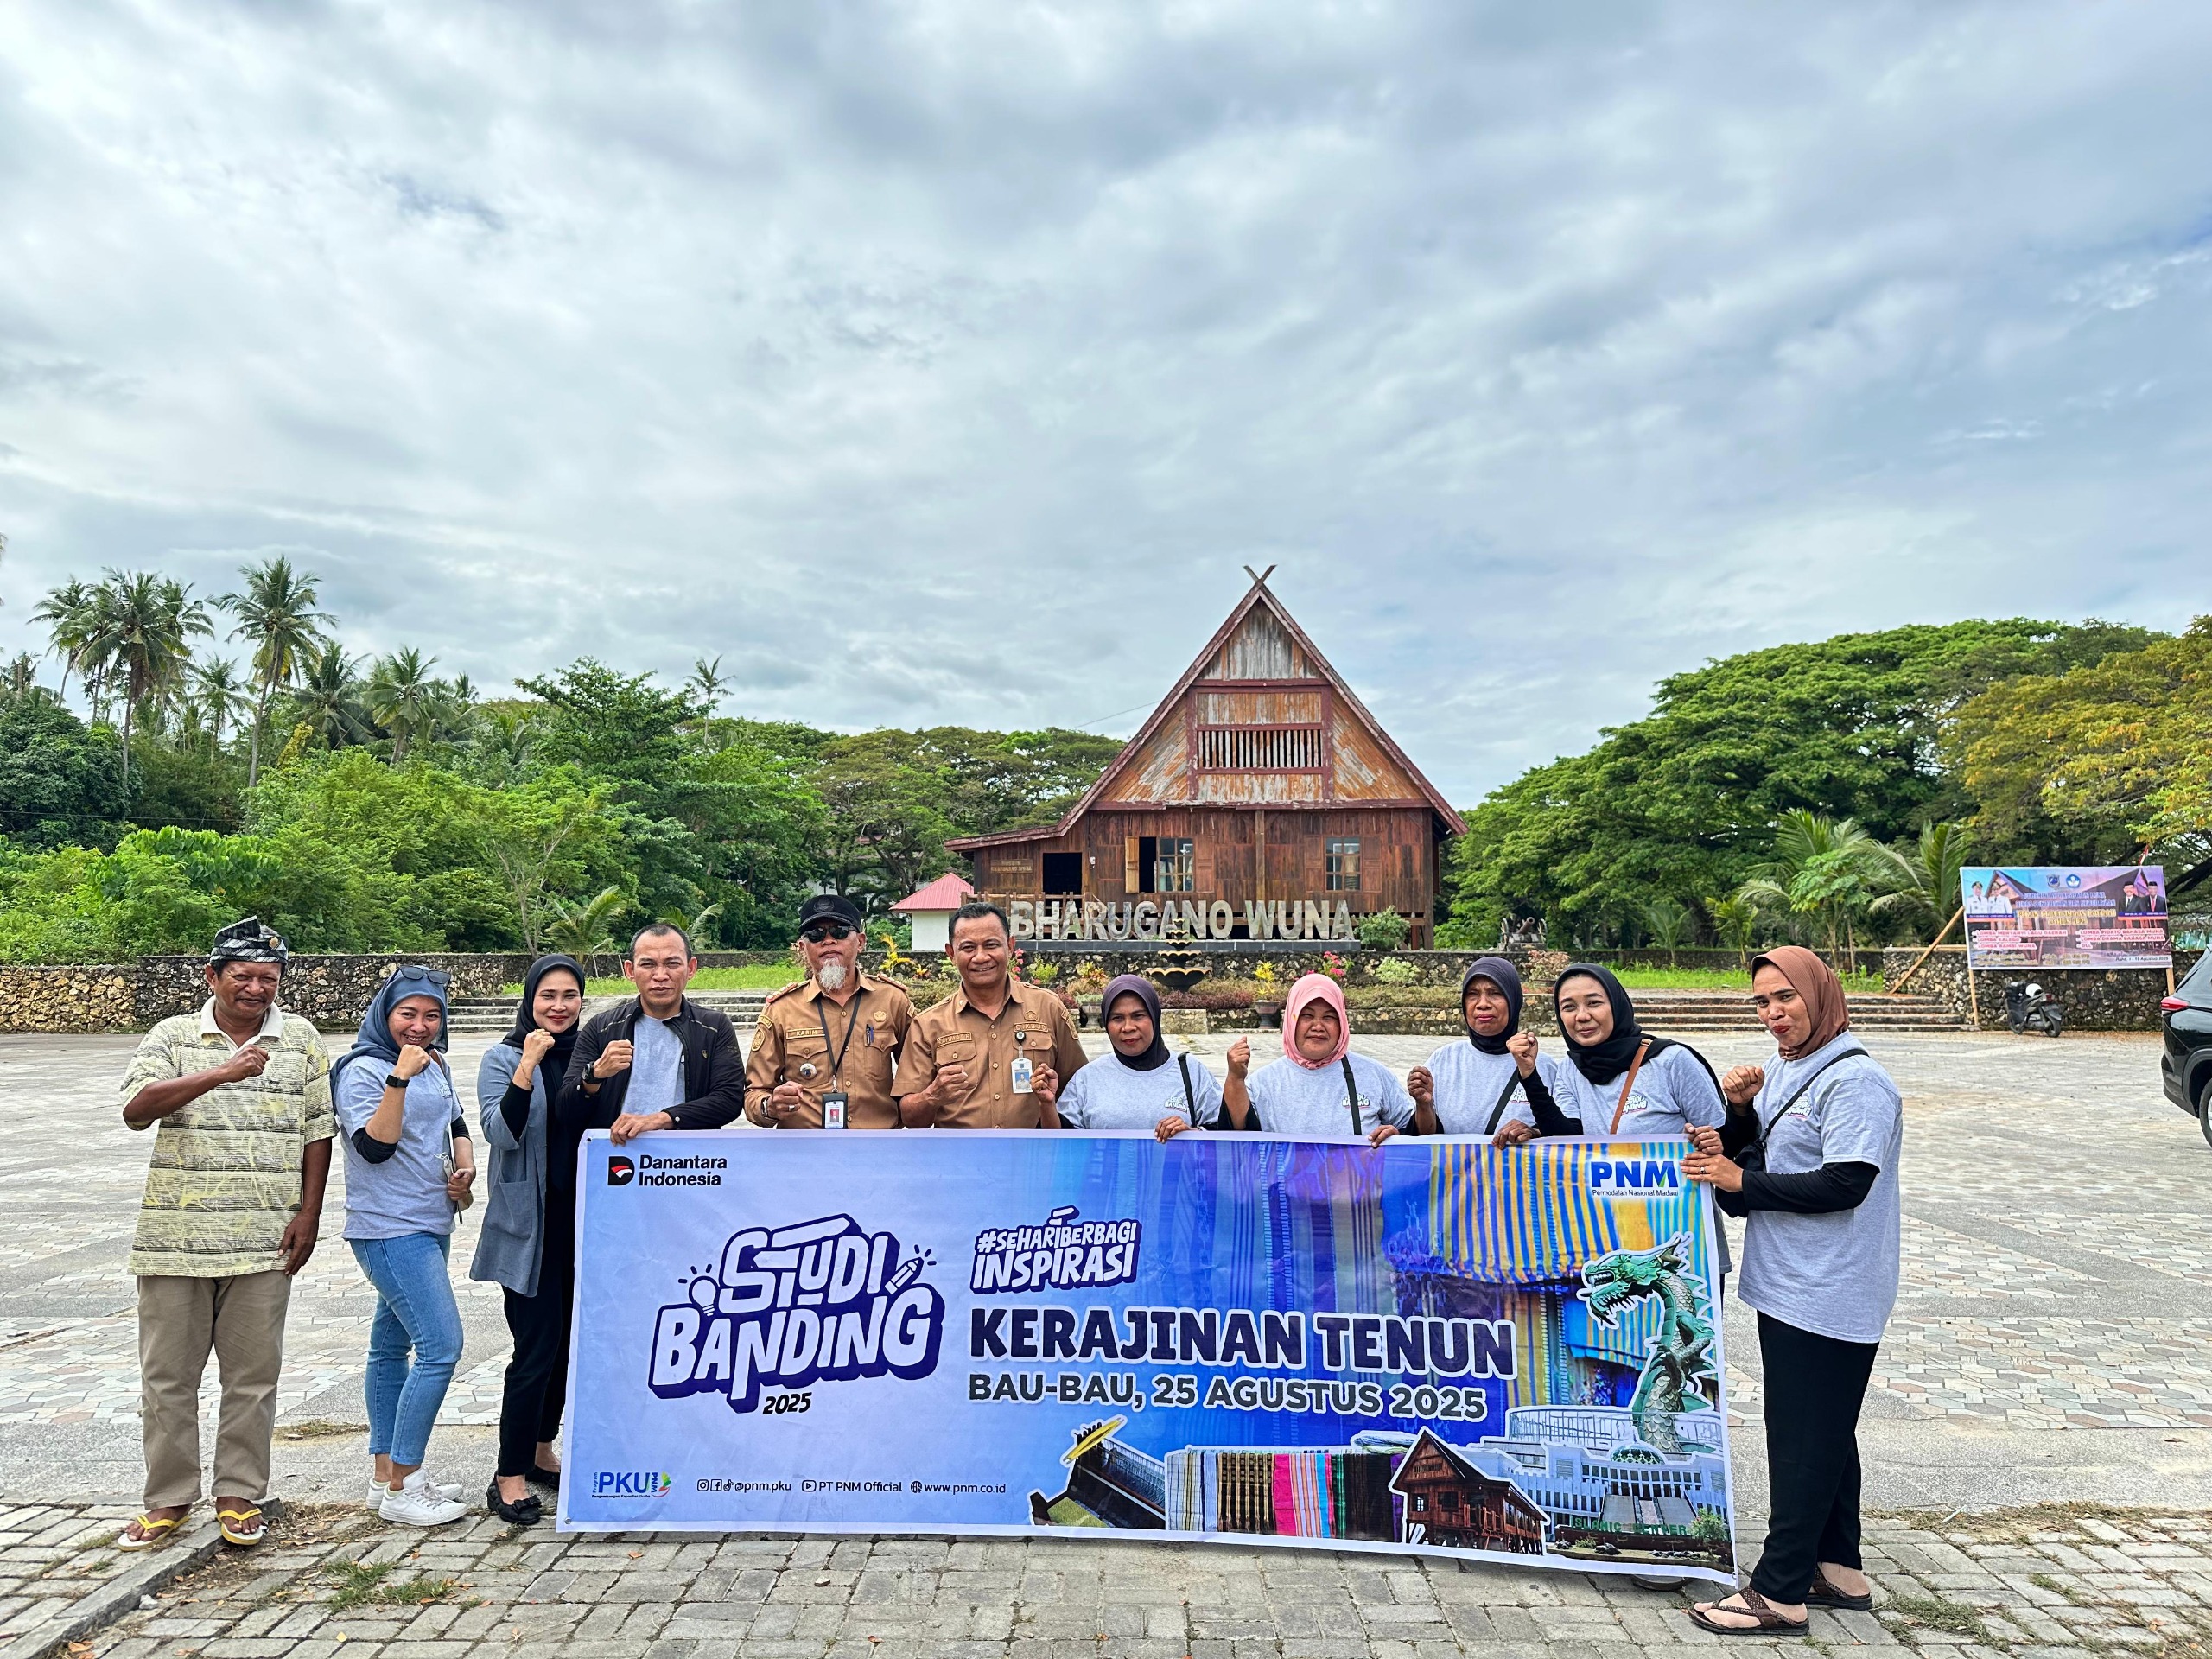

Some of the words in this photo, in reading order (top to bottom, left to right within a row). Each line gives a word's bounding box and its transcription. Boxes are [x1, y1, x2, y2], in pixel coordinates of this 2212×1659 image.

[1010, 900, 1234, 940] BHARUGANO
[1244, 899, 1356, 940] WUNA
[639, 1154, 728, 1169] Danantara
[1591, 1160, 1679, 1188] PNM
[639, 1172, 721, 1186] Indonesia
[976, 1218, 1138, 1253] #SEHARIBERBAGI
[717, 1215, 893, 1314] STUDI
[972, 1243, 1135, 1290] INSPIRASI
[650, 1286, 937, 1402] BANDING
[969, 1307, 1302, 1366] KERAJINAN
[1316, 1316, 1514, 1376] TENUN
[762, 1391, 812, 1414] 2025
[969, 1373, 1144, 1409] BAU-BAU,
[1153, 1376, 1197, 1405] 25
[1205, 1377, 1382, 1415] AGUSTUS
[1391, 1386, 1486, 1420] 2025
[598, 1471, 651, 1493] PKU
[734, 1480, 792, 1494] @pnm.pku
[818, 1481, 834, 1491] PT
[836, 1481, 861, 1491] PNM
[863, 1481, 903, 1492] Official
[924, 1483, 1007, 1495] www.pnm.co.id
[1570, 1517, 1622, 1533] ISLAMIC
